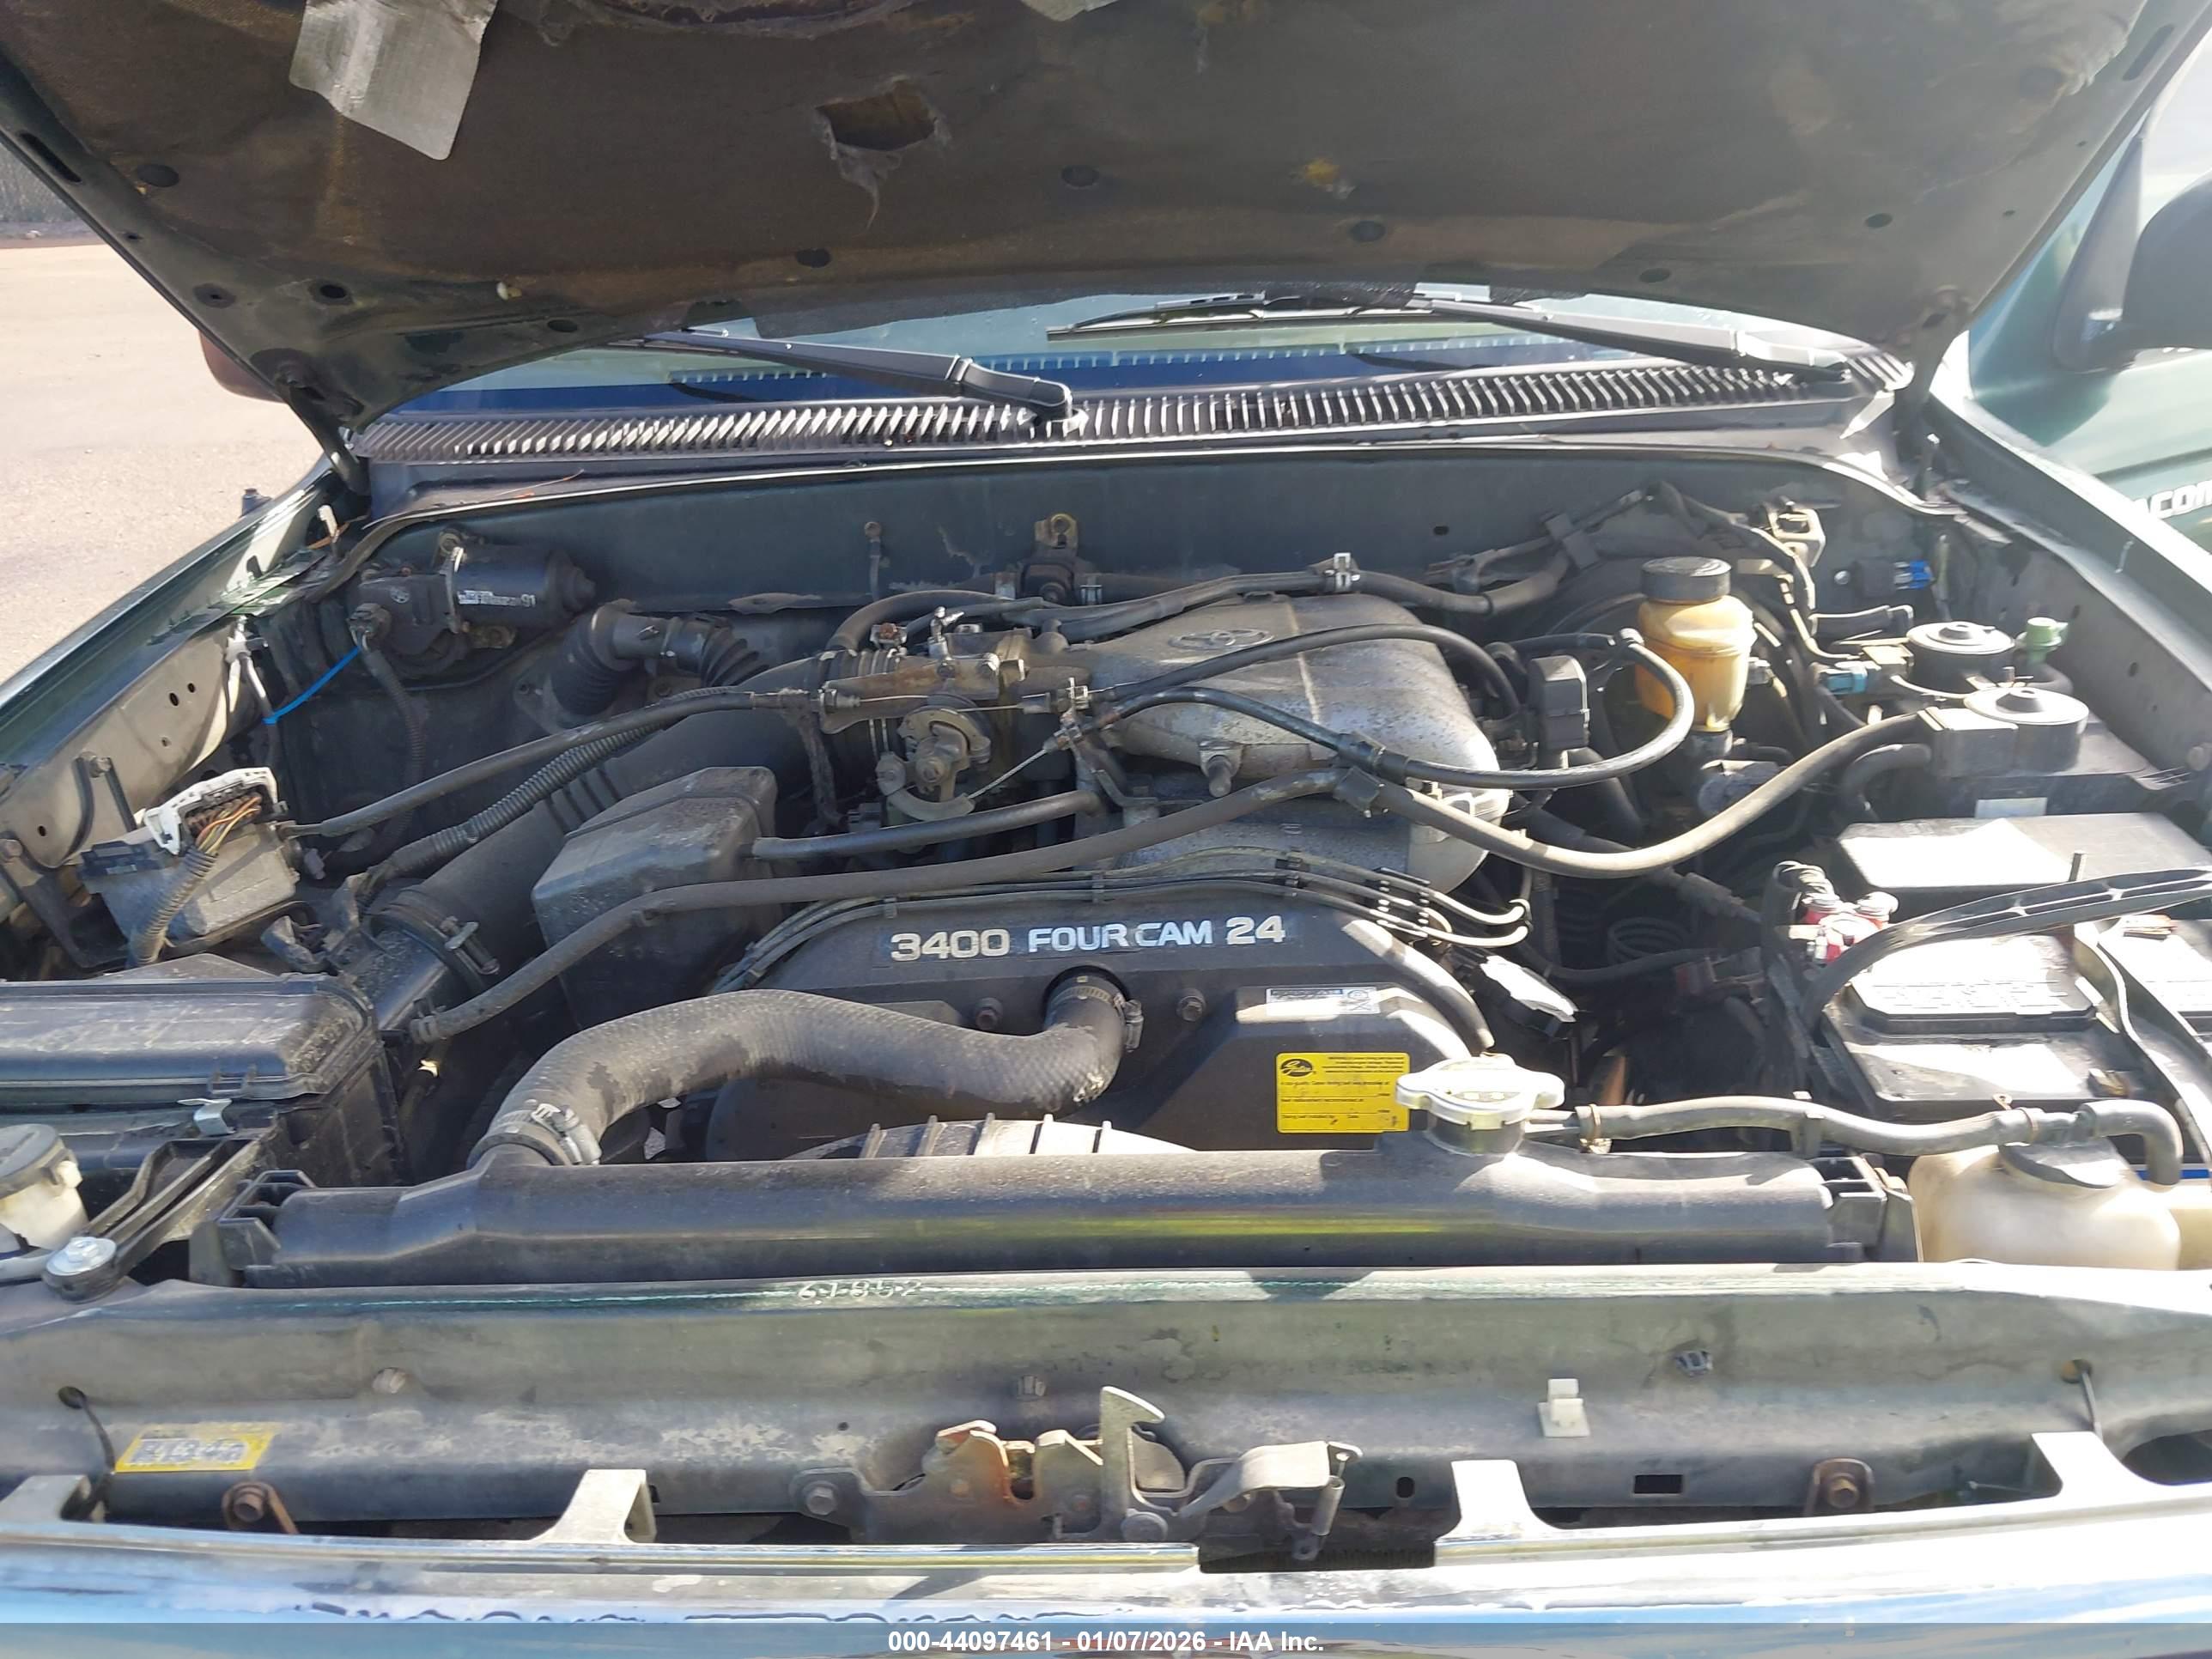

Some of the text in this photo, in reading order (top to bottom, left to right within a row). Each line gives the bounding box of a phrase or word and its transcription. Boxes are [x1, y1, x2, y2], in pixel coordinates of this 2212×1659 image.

[890, 915, 1286, 961] 3400 FOUR CAM 24
